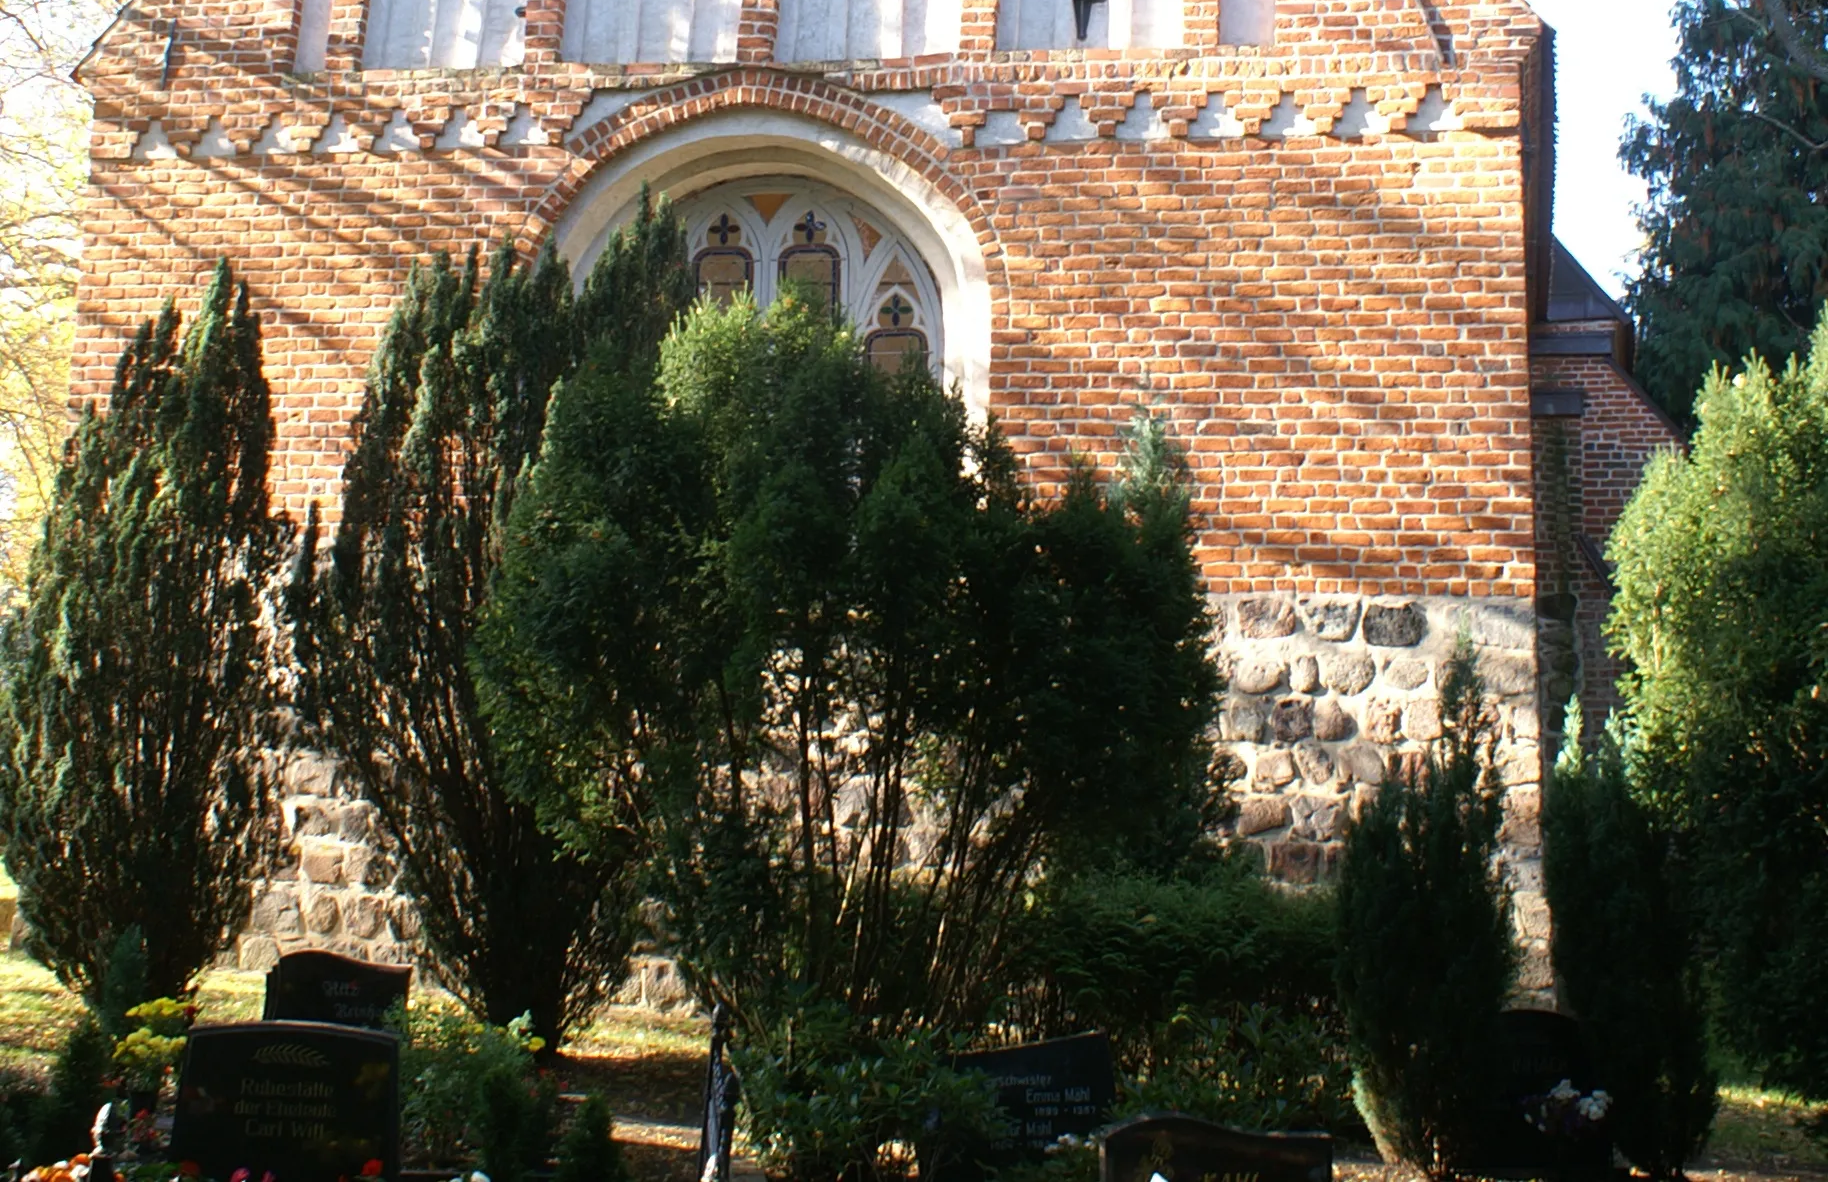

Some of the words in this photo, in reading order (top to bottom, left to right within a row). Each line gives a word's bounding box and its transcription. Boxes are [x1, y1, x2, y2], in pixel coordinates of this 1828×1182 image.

[1025, 1088, 1061, 1104] Emma
[234, 1099, 262, 1115] der
[245, 1118, 283, 1137] Carl
